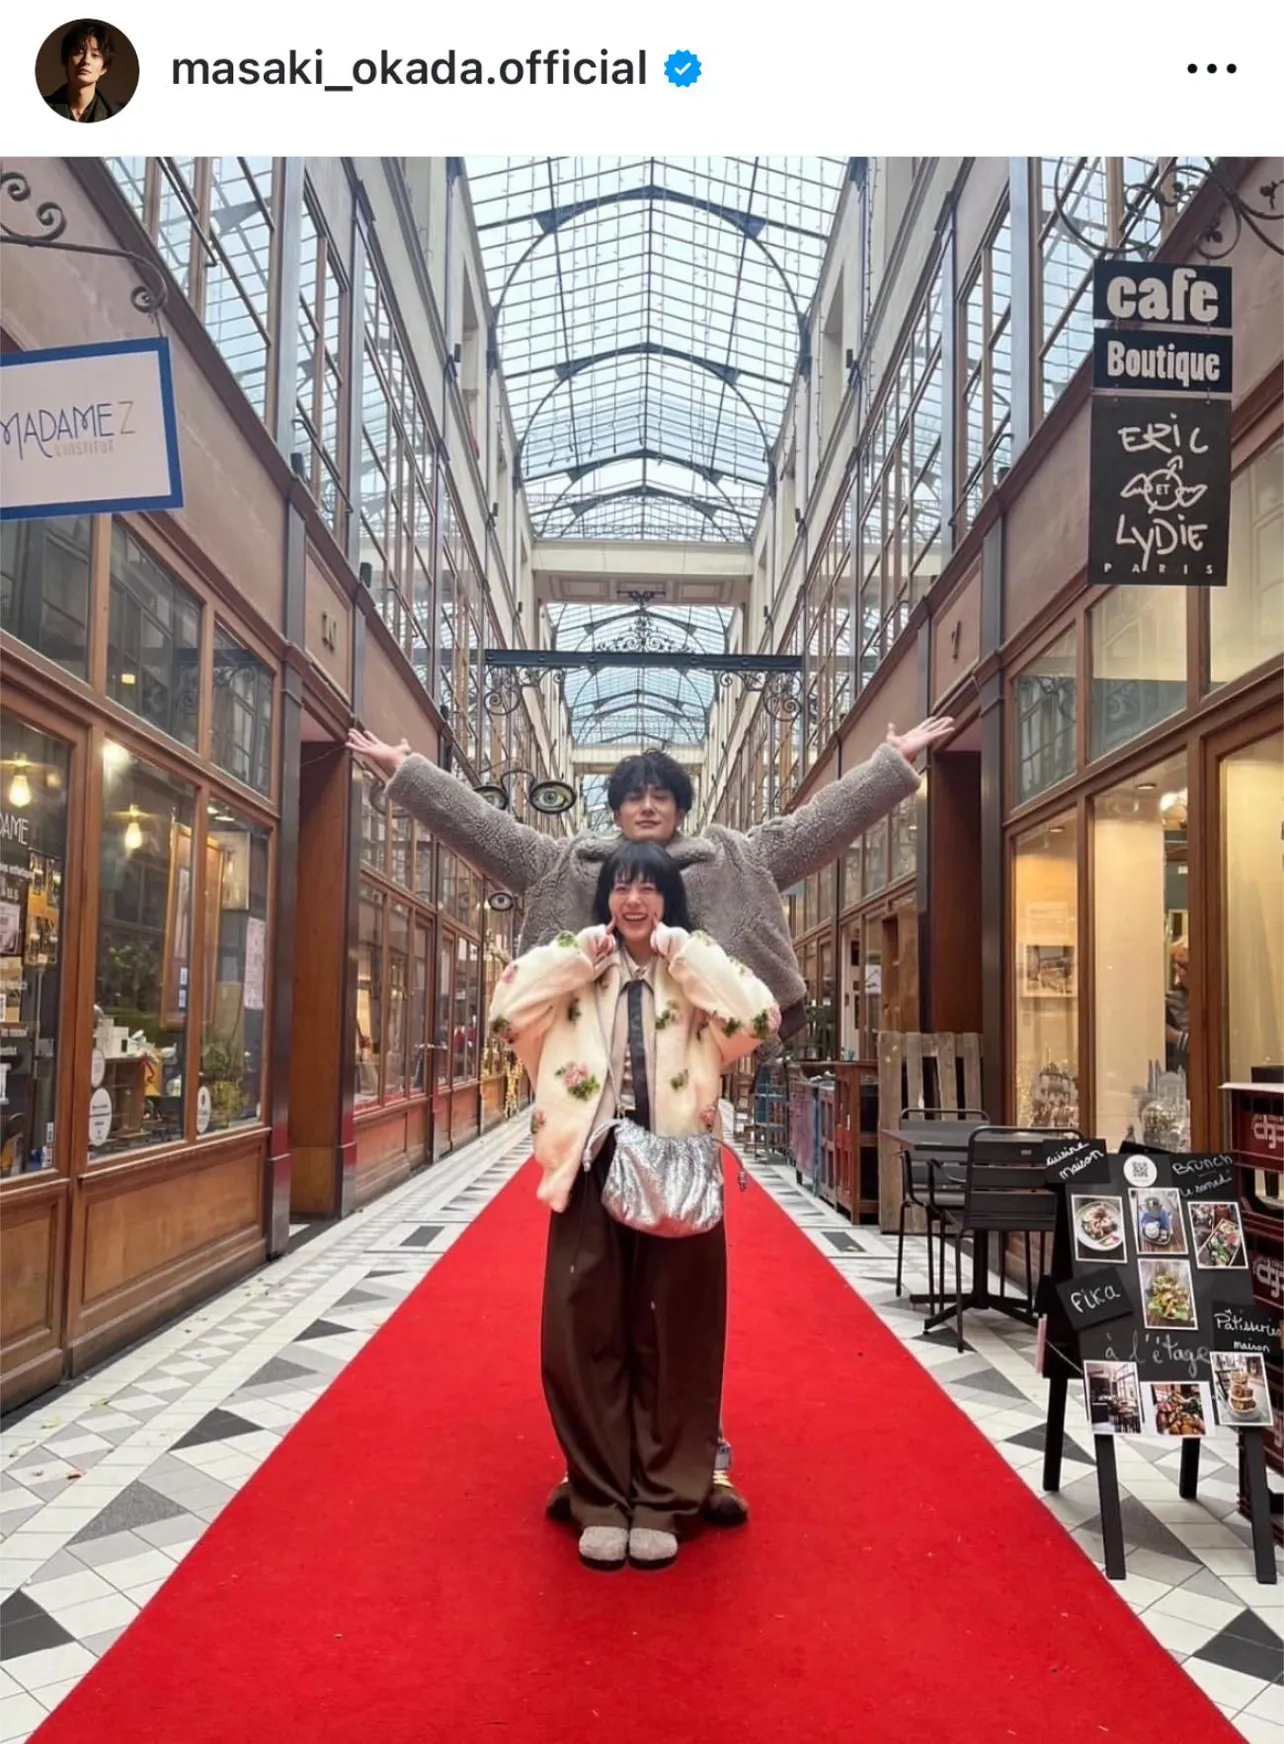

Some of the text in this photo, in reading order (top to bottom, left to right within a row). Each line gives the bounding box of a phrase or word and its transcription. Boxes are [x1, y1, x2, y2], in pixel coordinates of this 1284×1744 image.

[1106, 267, 1219, 322] cafe
[1107, 340, 1220, 388] Boutique
[1156, 484, 1170, 496] ET
[1104, 562, 1214, 575] PARIS
[1172, 1154, 1233, 1175] Brunch
